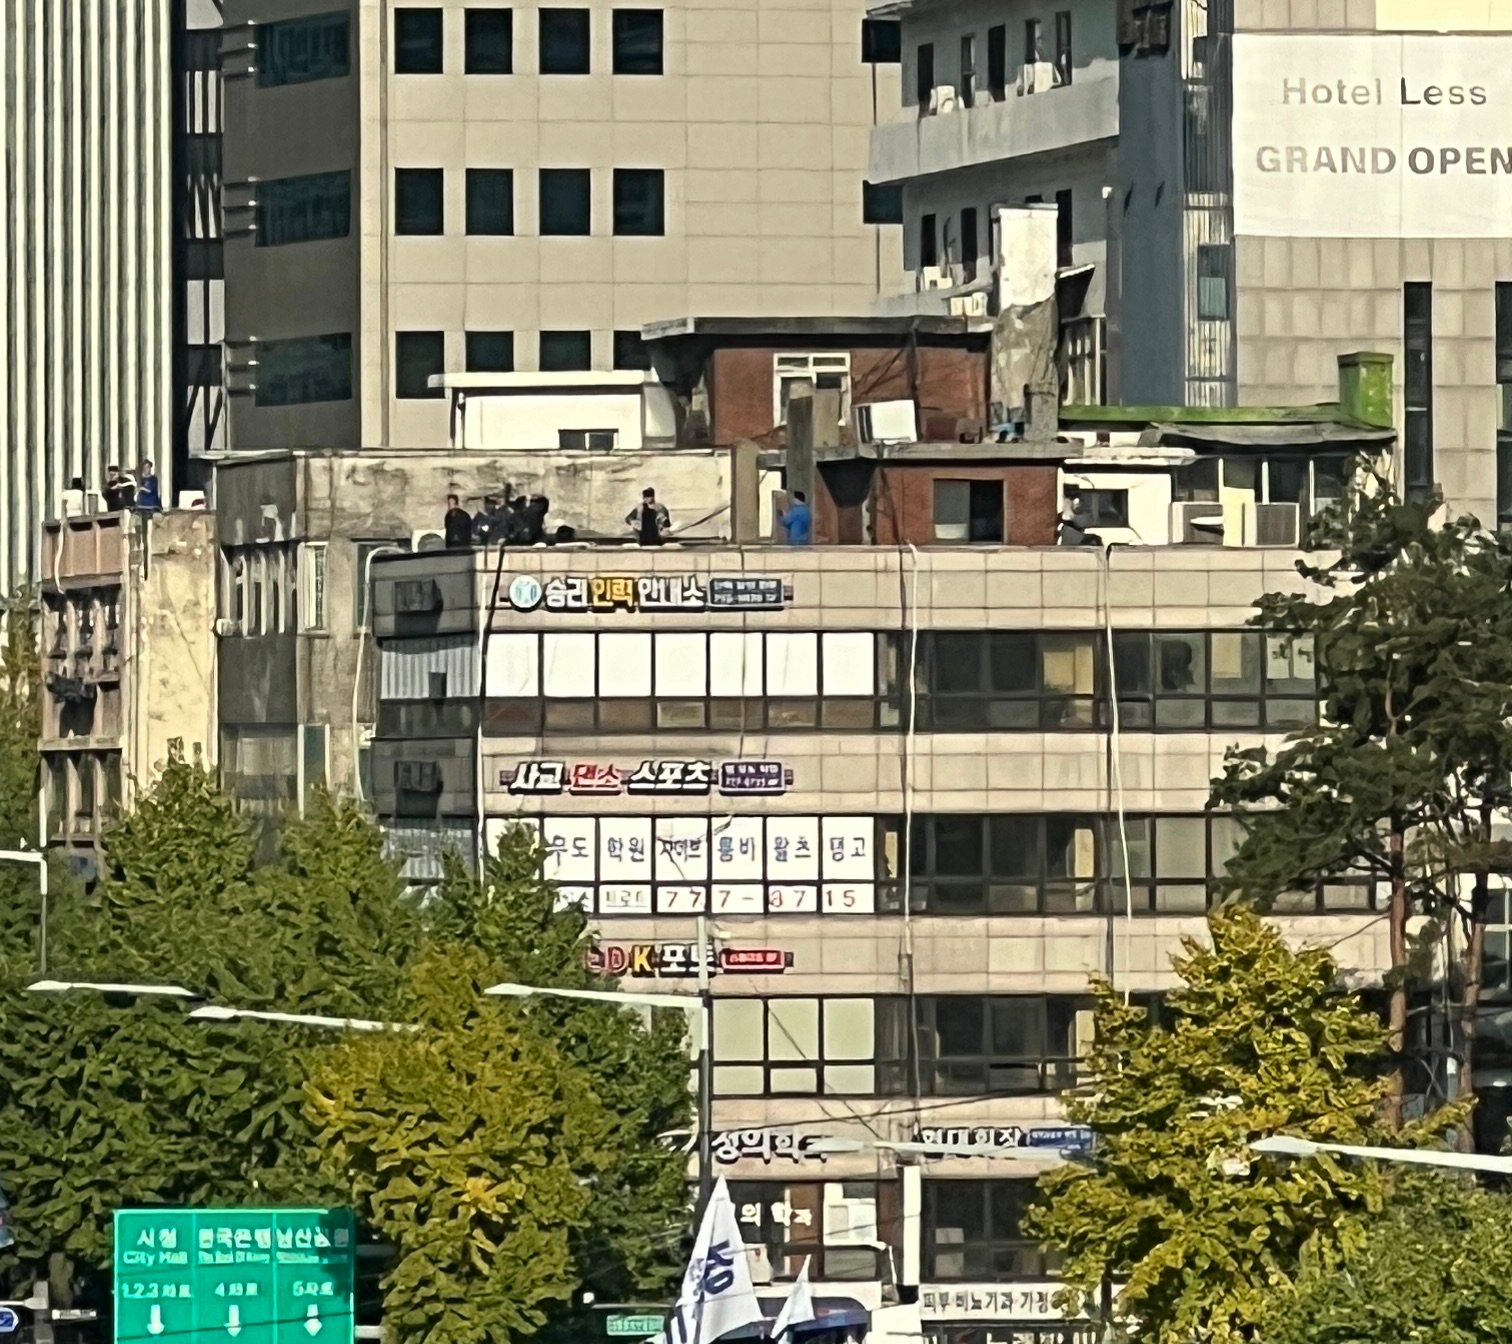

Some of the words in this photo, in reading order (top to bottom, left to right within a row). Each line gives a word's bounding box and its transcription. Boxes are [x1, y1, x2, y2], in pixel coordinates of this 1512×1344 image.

[1283, 77, 1382, 106] Hotel
[1401, 77, 1487, 106] Less
[1256, 146, 1397, 175] GRAND
